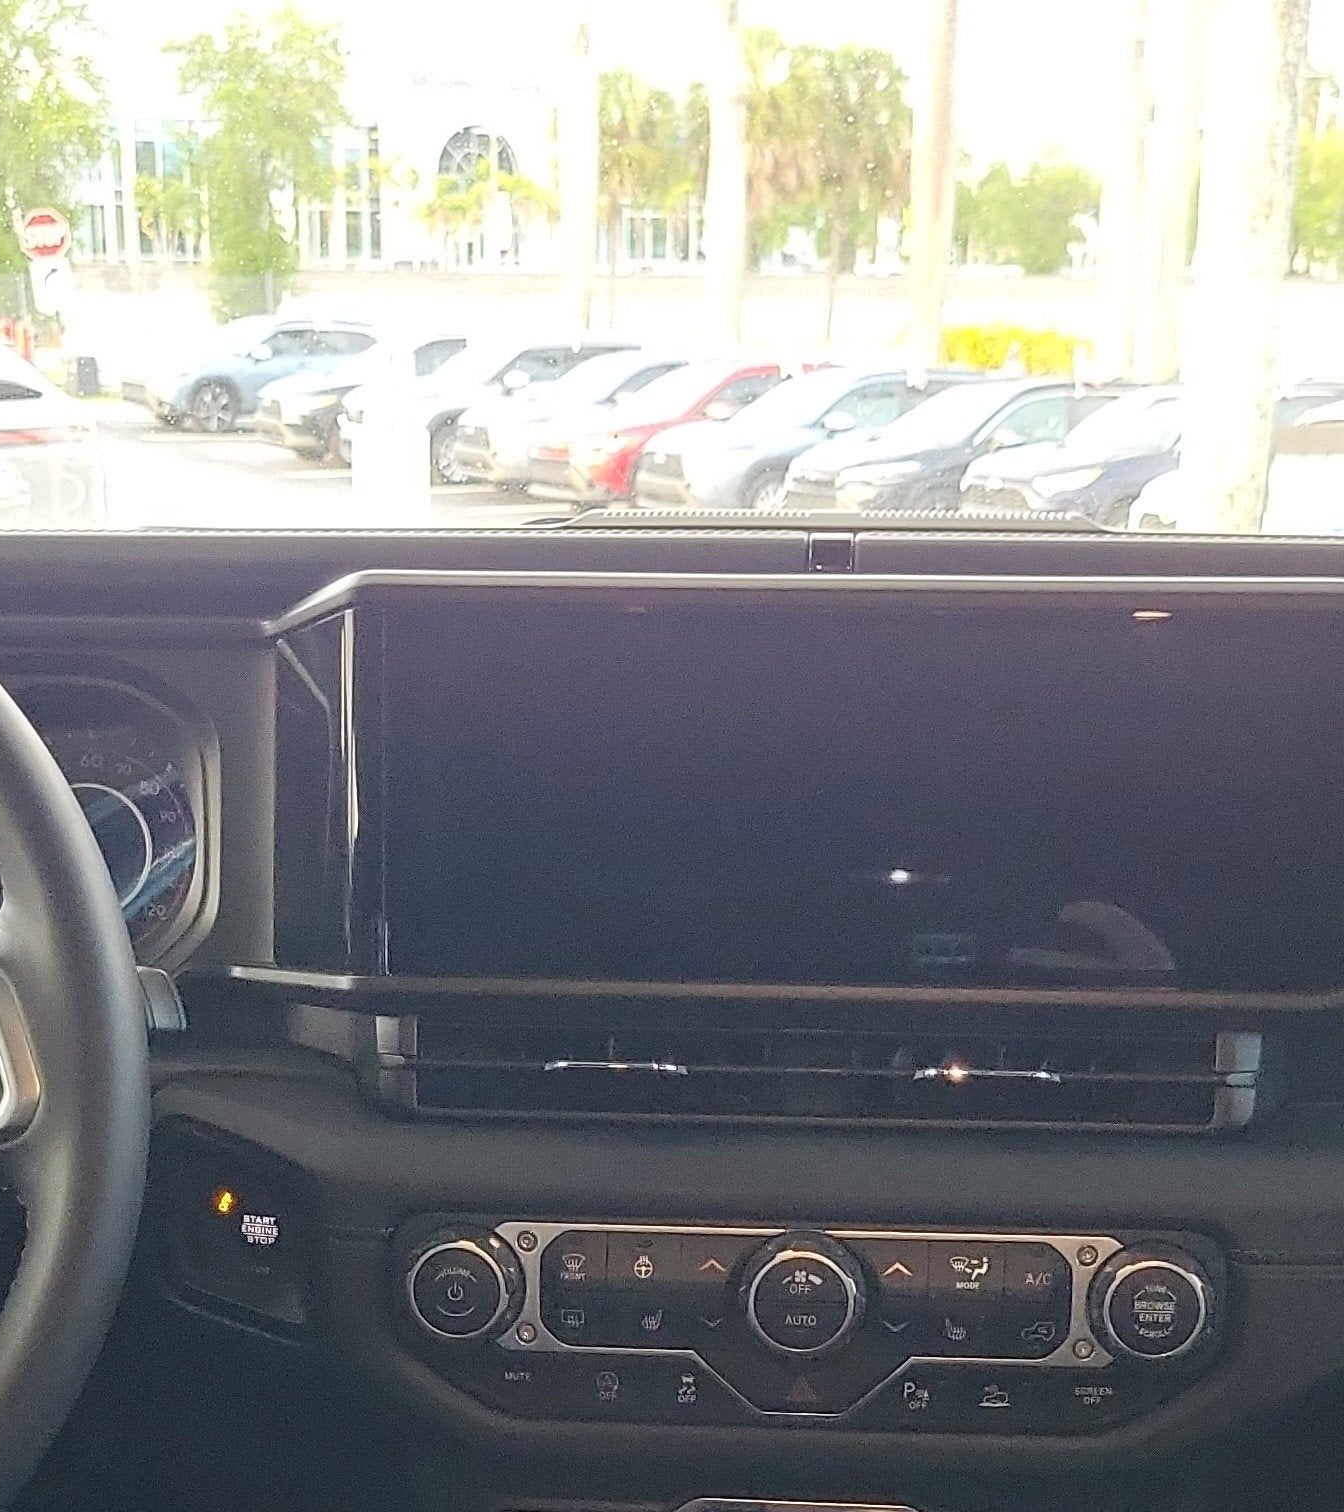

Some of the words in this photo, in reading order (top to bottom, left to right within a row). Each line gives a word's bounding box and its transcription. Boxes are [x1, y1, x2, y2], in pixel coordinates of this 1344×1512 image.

[243, 1214, 276, 1225] START
[241, 1224, 279, 1236] ENGINE
[246, 1236, 276, 1245] STOP
[1025, 1272, 1052, 1286] A/C
[789, 1284, 811, 1295] OFF
[956, 1281, 981, 1290] MODE
[1134, 1301, 1175, 1311] BROWSE
[784, 1315, 817, 1327] AUTO
[1138, 1313, 1172, 1323] ENTER
